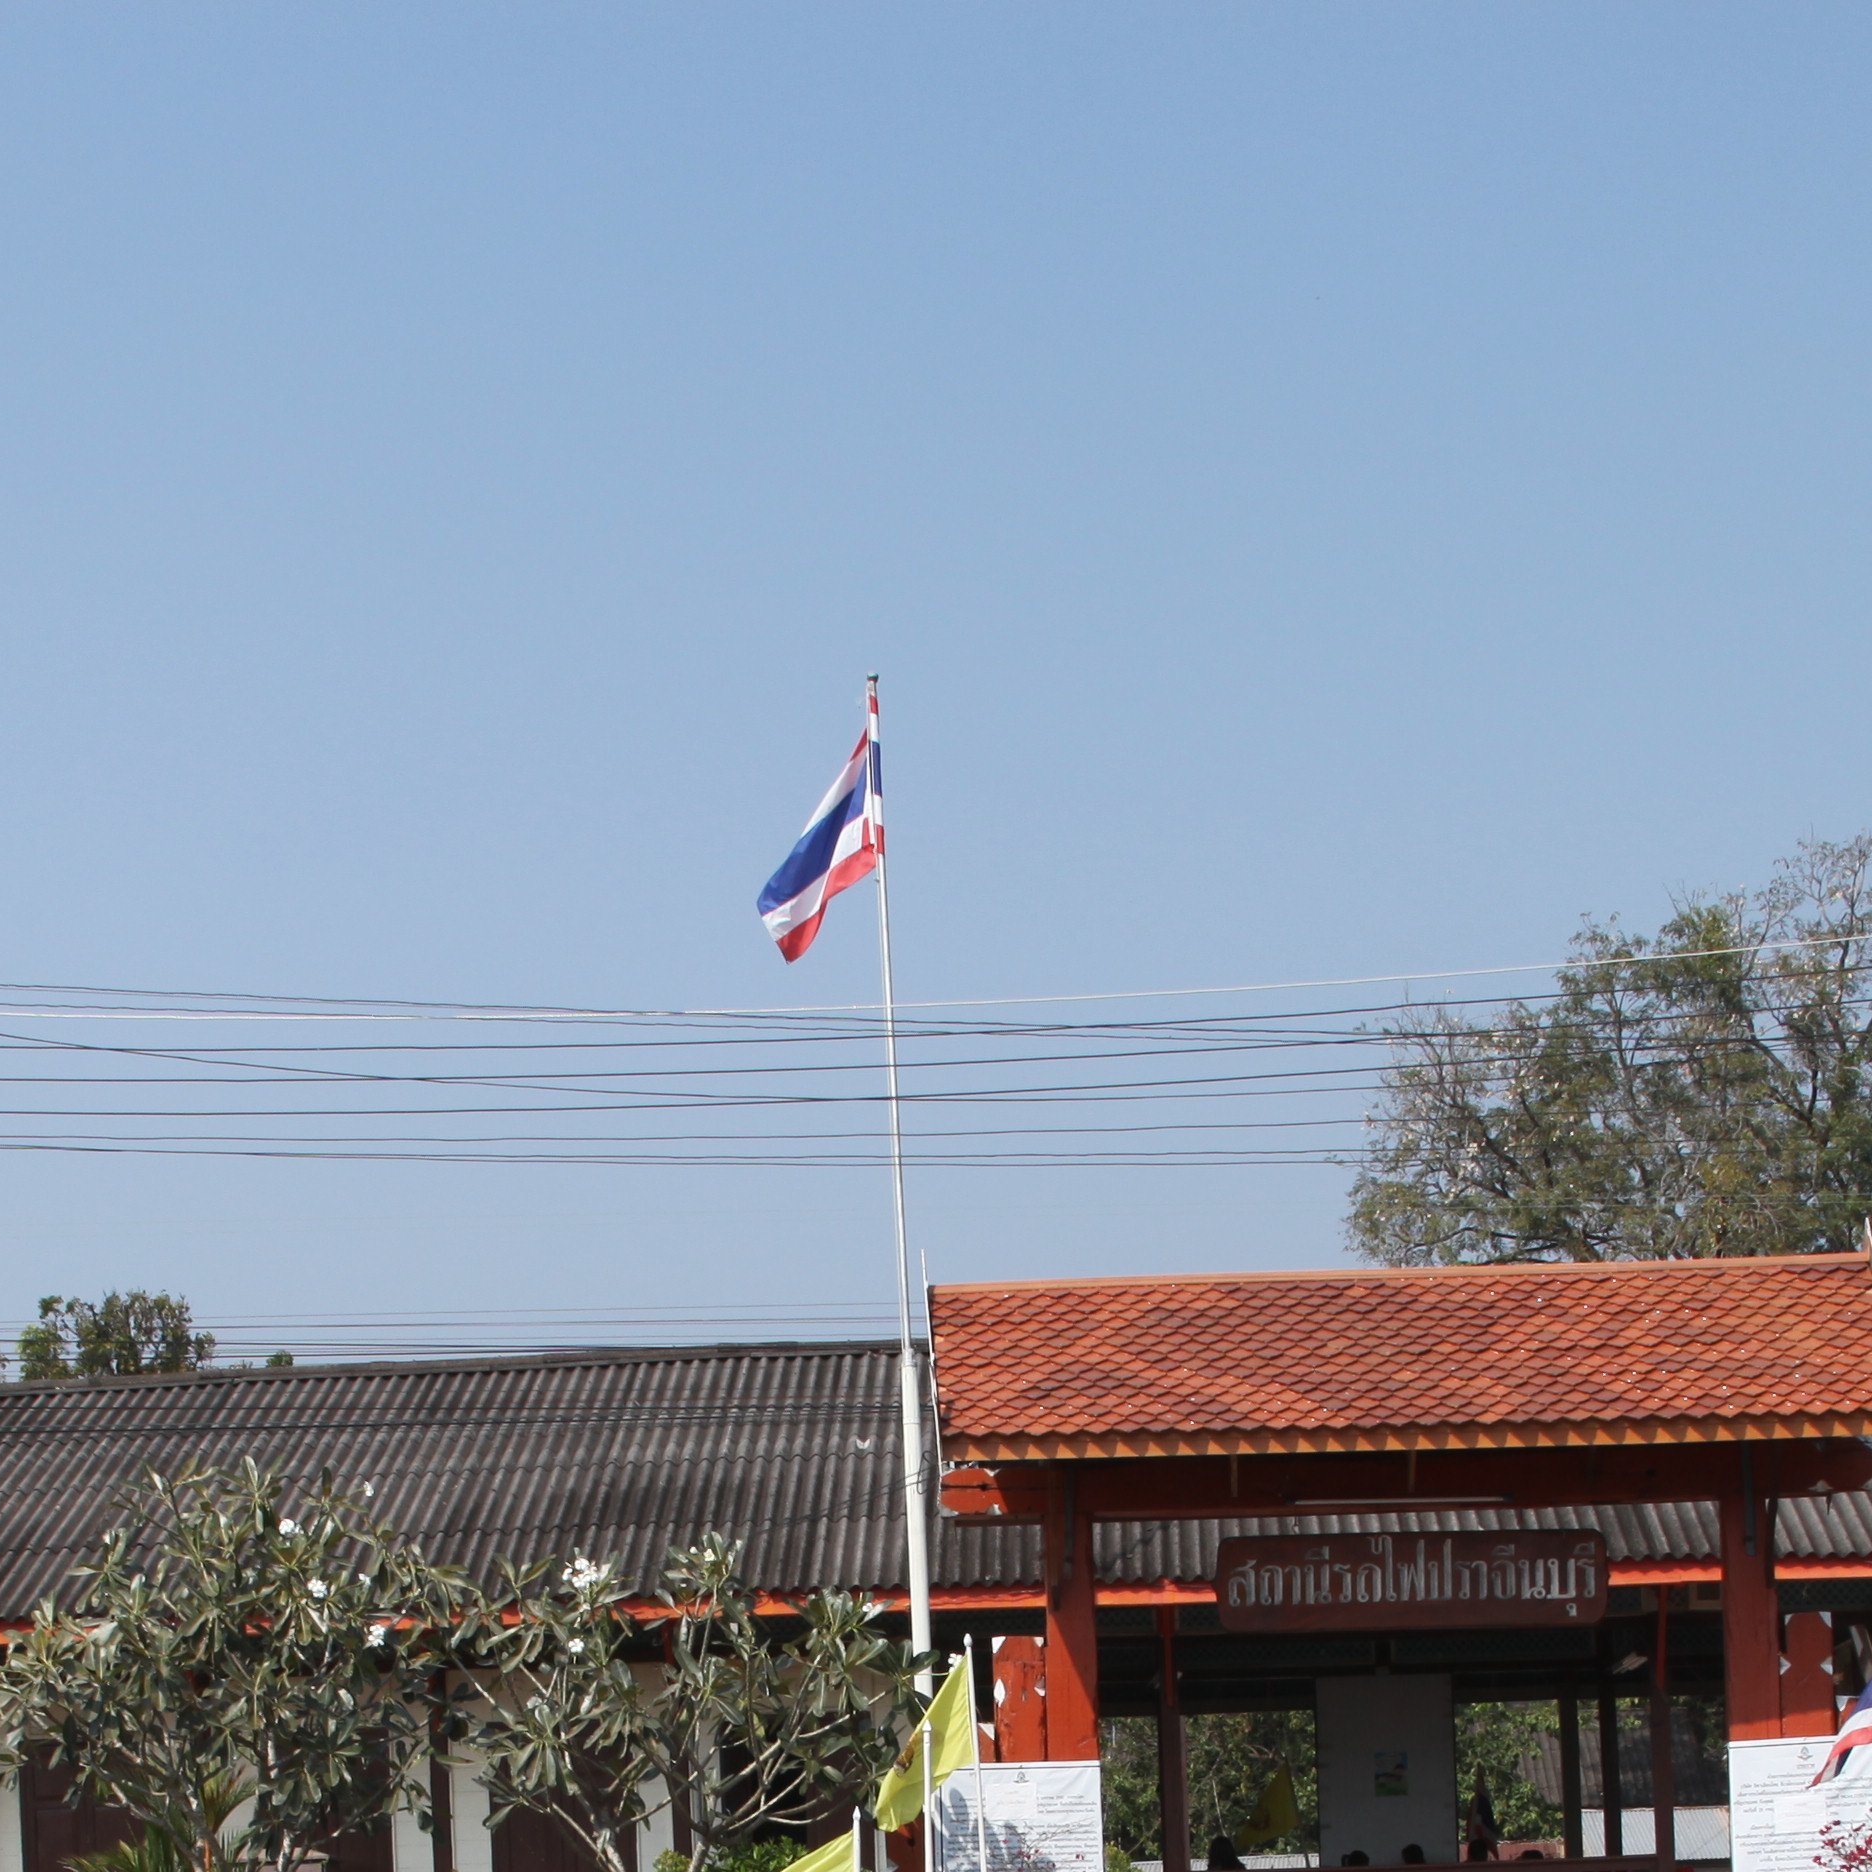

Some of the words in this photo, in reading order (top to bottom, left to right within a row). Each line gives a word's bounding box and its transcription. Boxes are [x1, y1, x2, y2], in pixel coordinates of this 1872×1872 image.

[1228, 1535, 1596, 1617] สถานีรถไฟปราจีนบุรี
